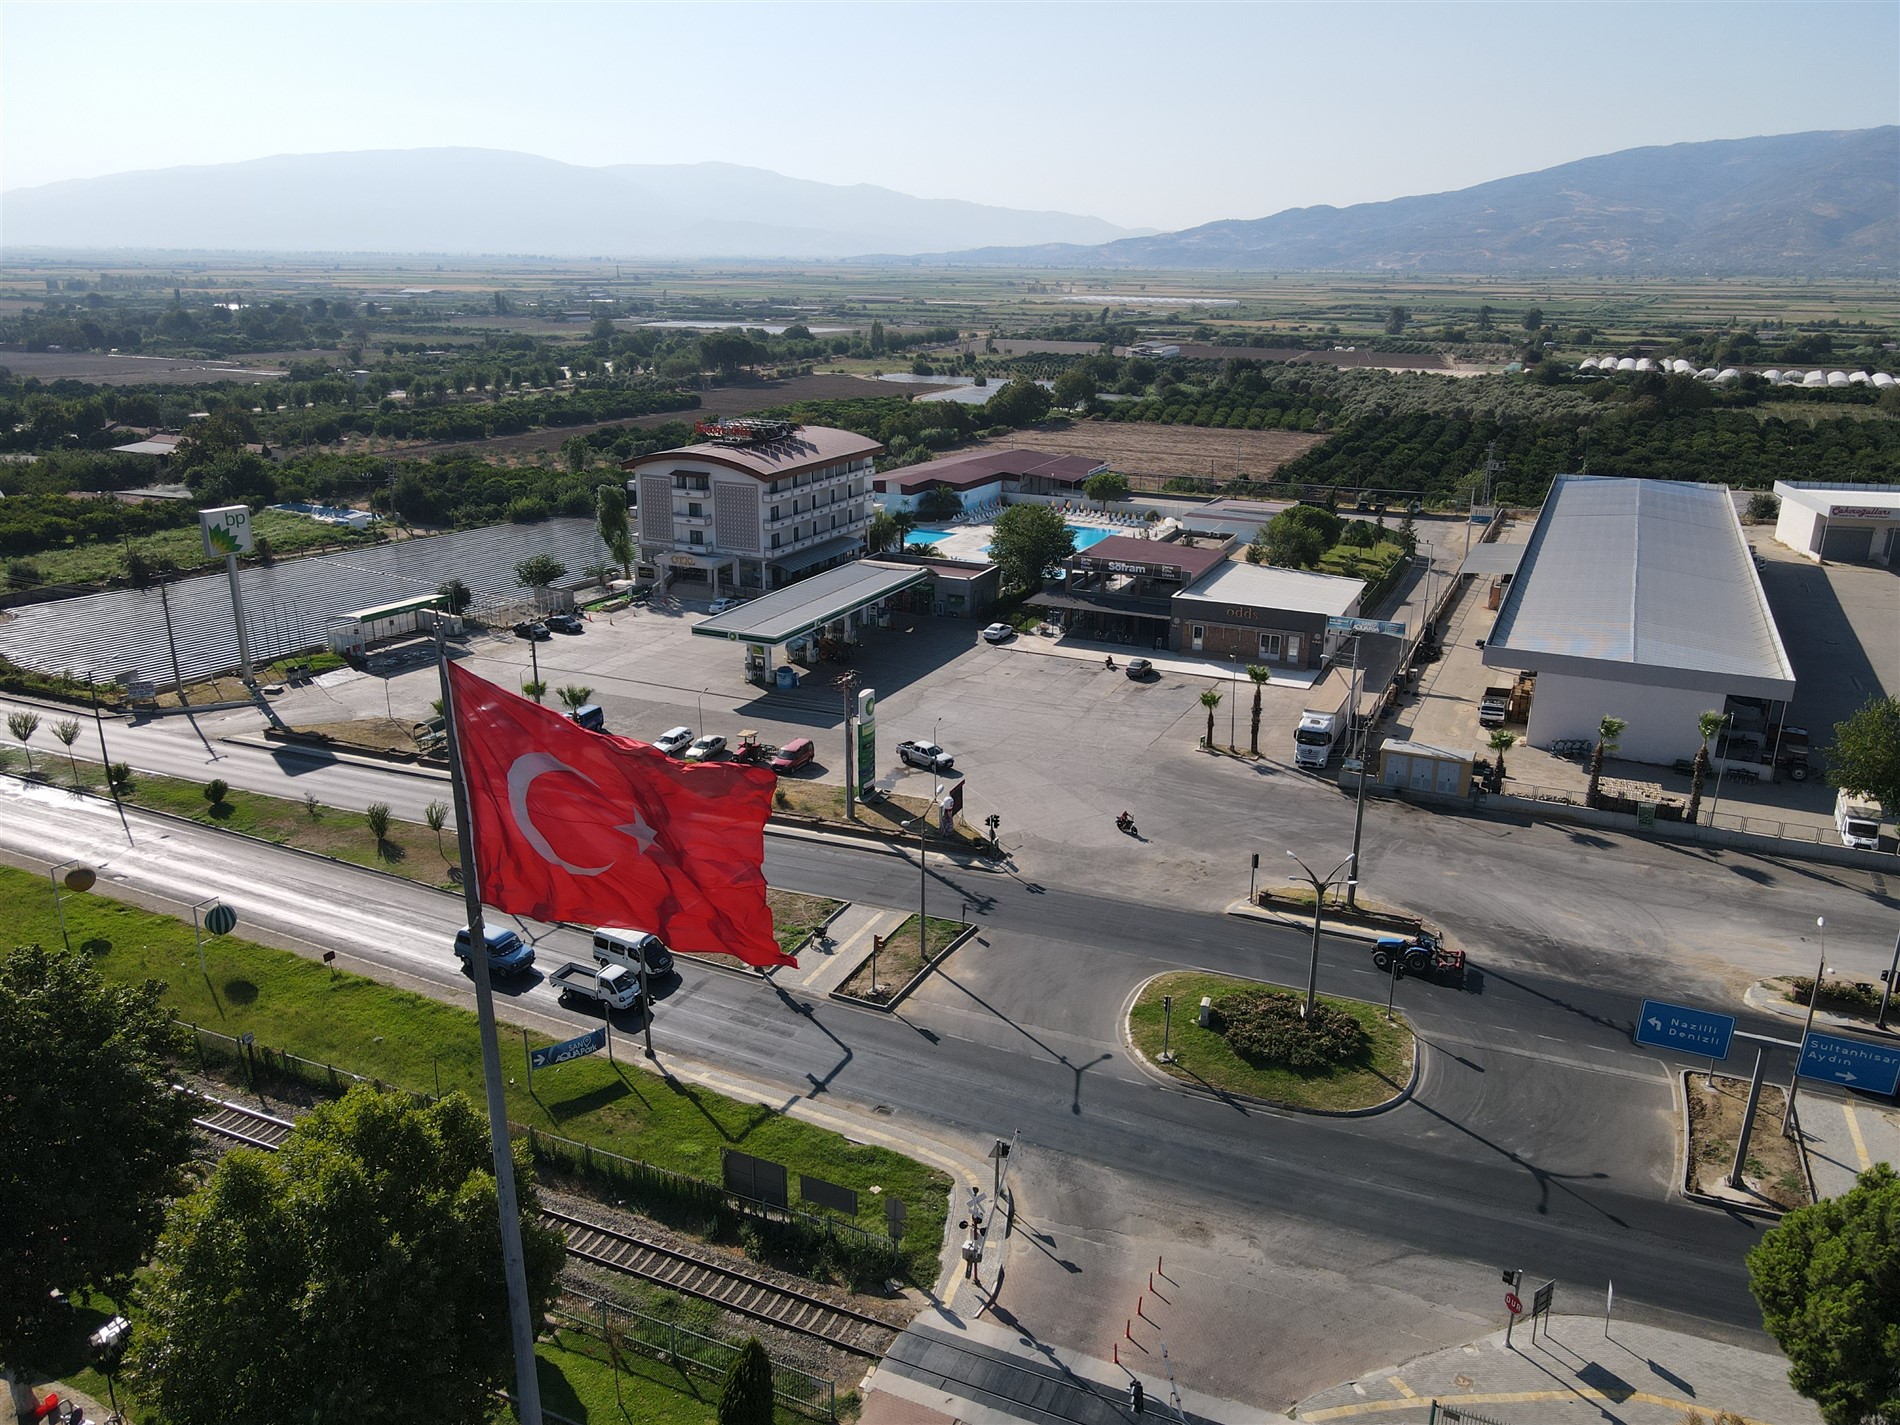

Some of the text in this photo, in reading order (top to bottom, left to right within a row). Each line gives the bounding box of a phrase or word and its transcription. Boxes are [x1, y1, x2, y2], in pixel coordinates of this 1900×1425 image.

[225, 513, 245, 528] bp
[1226, 606, 1258, 619] odds
[1671, 1018, 1718, 1034] Nazilli
[1669, 1028, 1719, 1045] Denizli
[1808, 1051, 1851, 1066] Aydın
[1810, 1040, 1898, 1064] Sultanhisar
[1506, 1295, 1521, 1311] DUR
